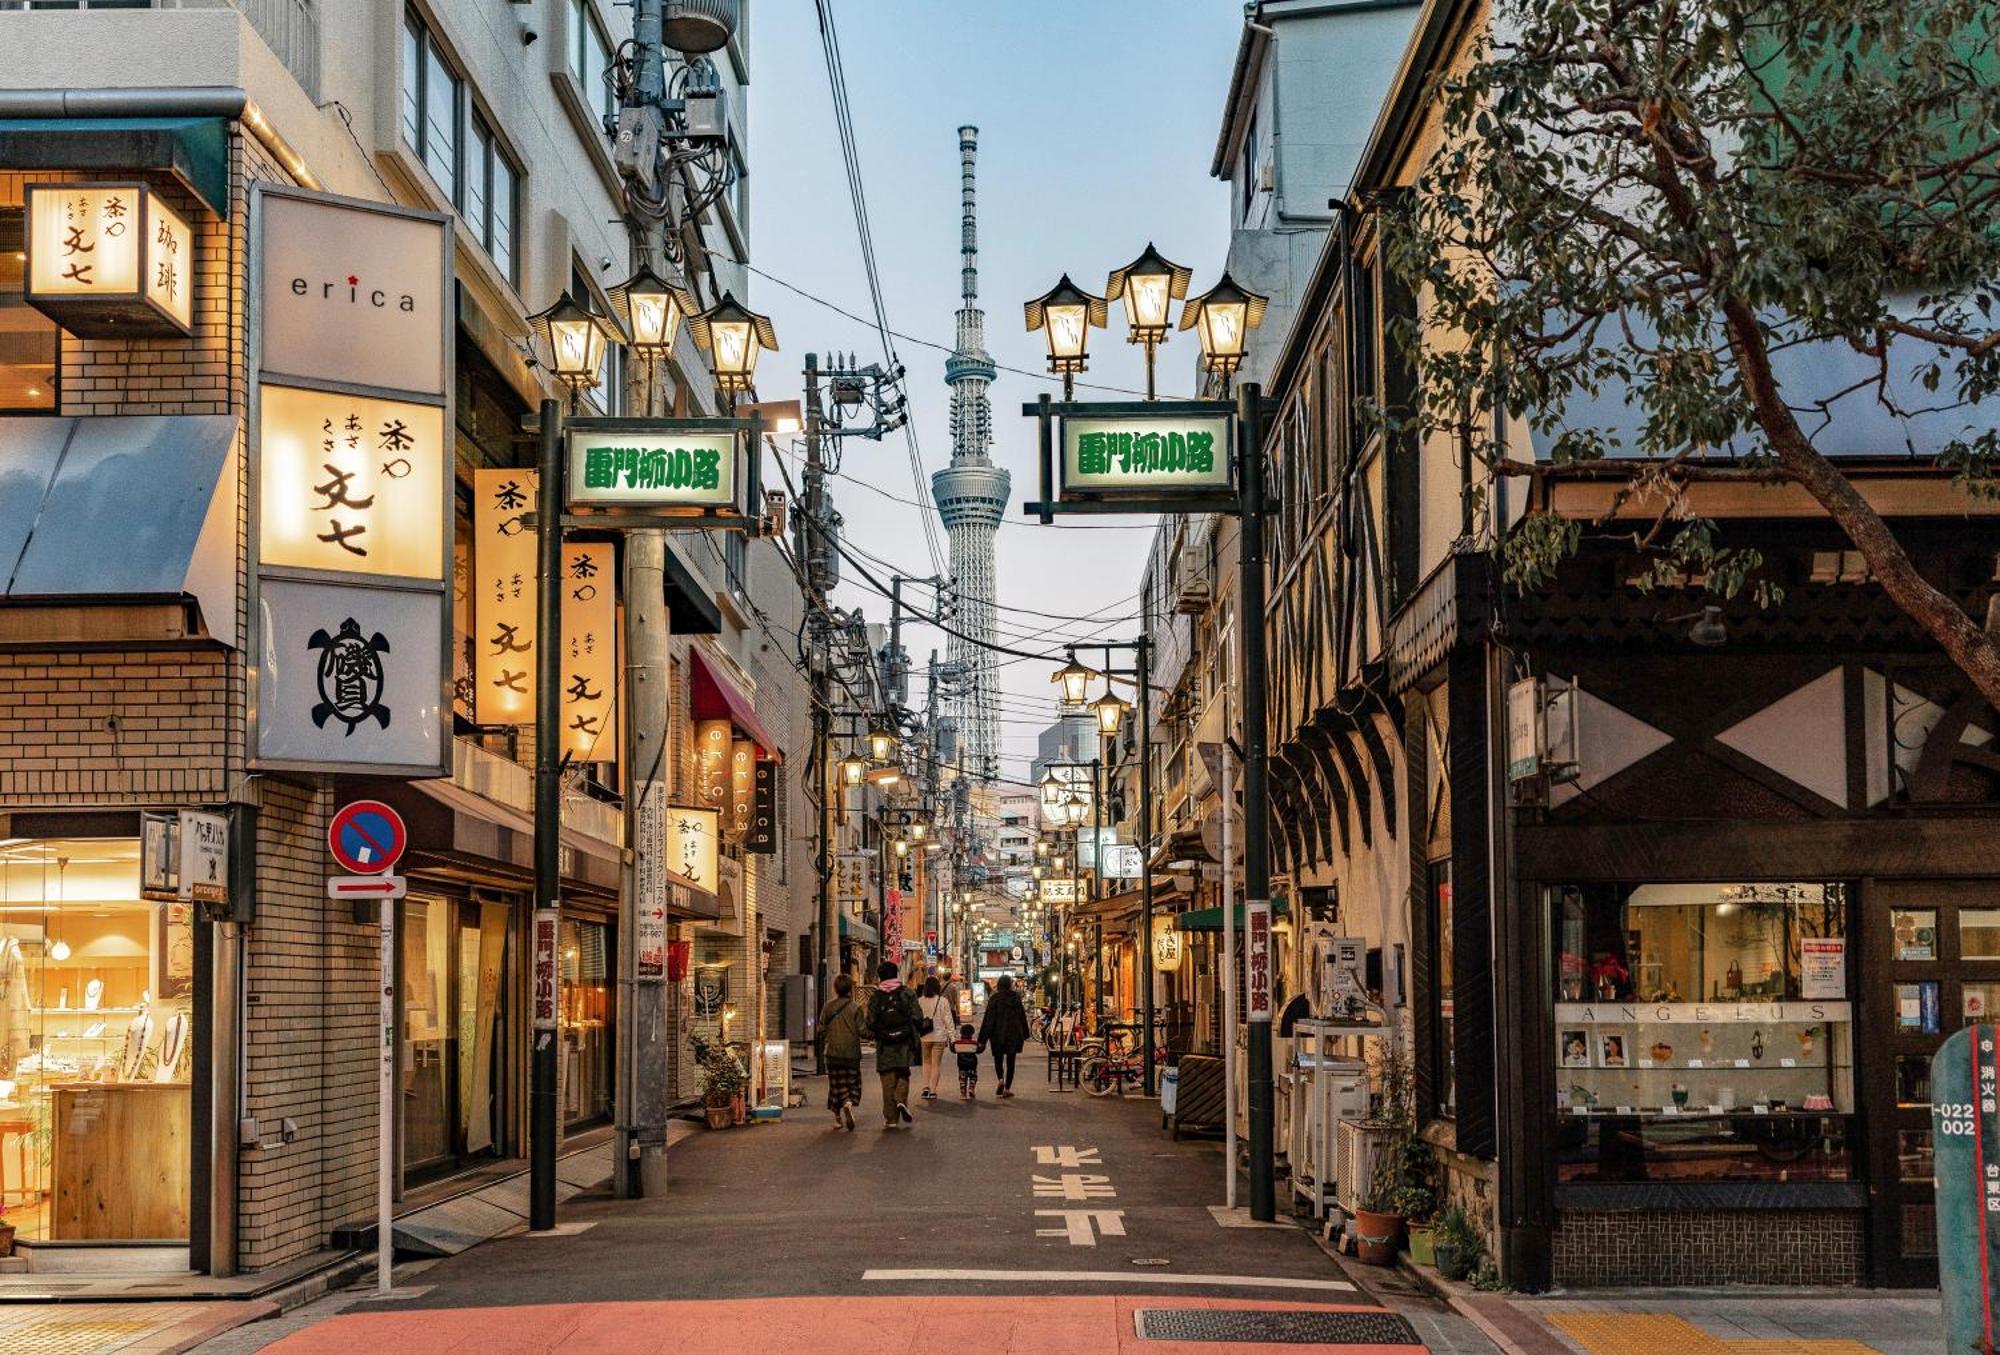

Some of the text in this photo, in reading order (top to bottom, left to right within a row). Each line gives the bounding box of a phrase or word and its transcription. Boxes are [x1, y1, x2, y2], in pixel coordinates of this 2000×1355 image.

[291, 275, 414, 312] erica
[585, 446, 721, 490] 雷門柳小路
[1078, 431, 1214, 474] 雷門柳小路
[310, 464, 375, 557] 文七
[735, 751, 755, 831] erica
[756, 769, 774, 843] erica
[1582, 1005, 1824, 1021] ANGELUS
[1981, 1065, 1997, 1114] 消火器
[1941, 1119, 1976, 1136] 002
[1985, 1163, 2000, 1212] 台東区
